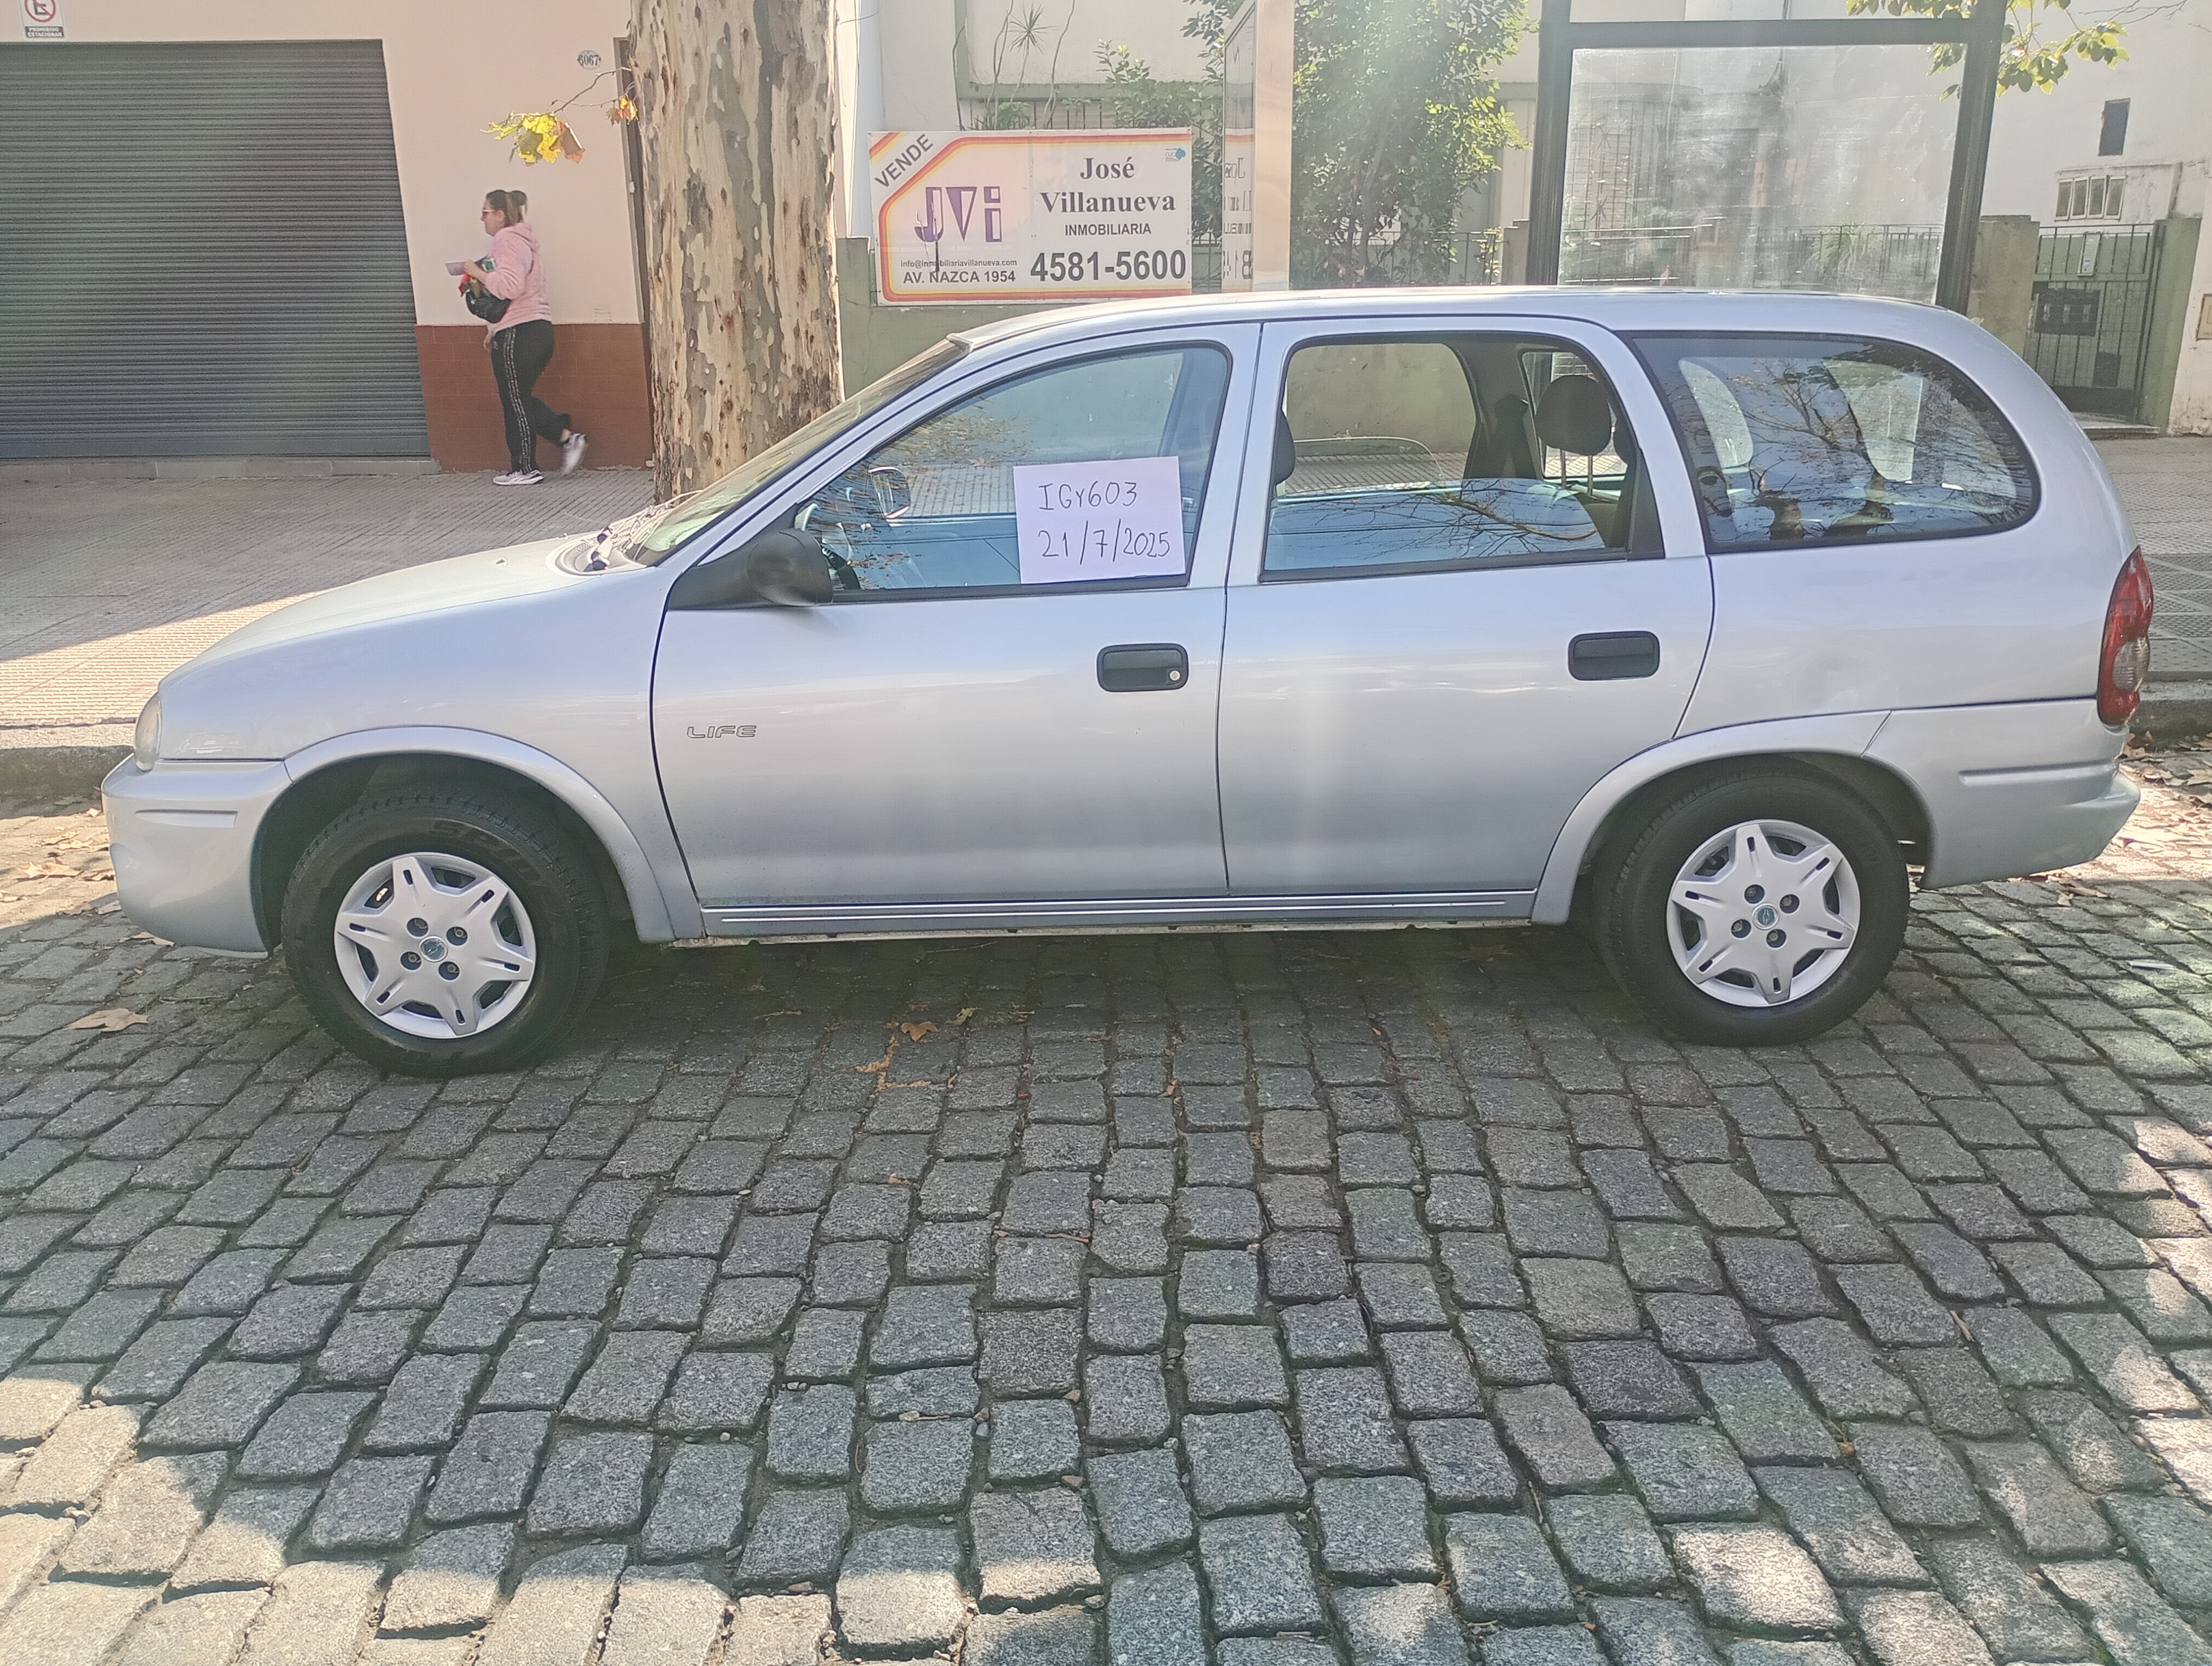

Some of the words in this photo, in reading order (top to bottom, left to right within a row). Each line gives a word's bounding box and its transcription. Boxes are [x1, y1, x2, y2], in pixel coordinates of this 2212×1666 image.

[578, 54, 599, 66] 6067
[874, 133, 934, 188] VENDE
[1080, 156, 1135, 179] José
[1039, 191, 1176, 213] Villanueva
[1065, 223, 1152, 236] INMOBILIARIA
[903, 272, 924, 283] AV.
[929, 271, 980, 283] NAZCA
[983, 270, 1016, 282] 1954
[1030, 249, 1186, 282] 4581-5600
[1038, 480, 1137, 510] IGY603
[1038, 518, 1171, 565] 21/7/2025
[686, 725, 757, 738] LIFE
